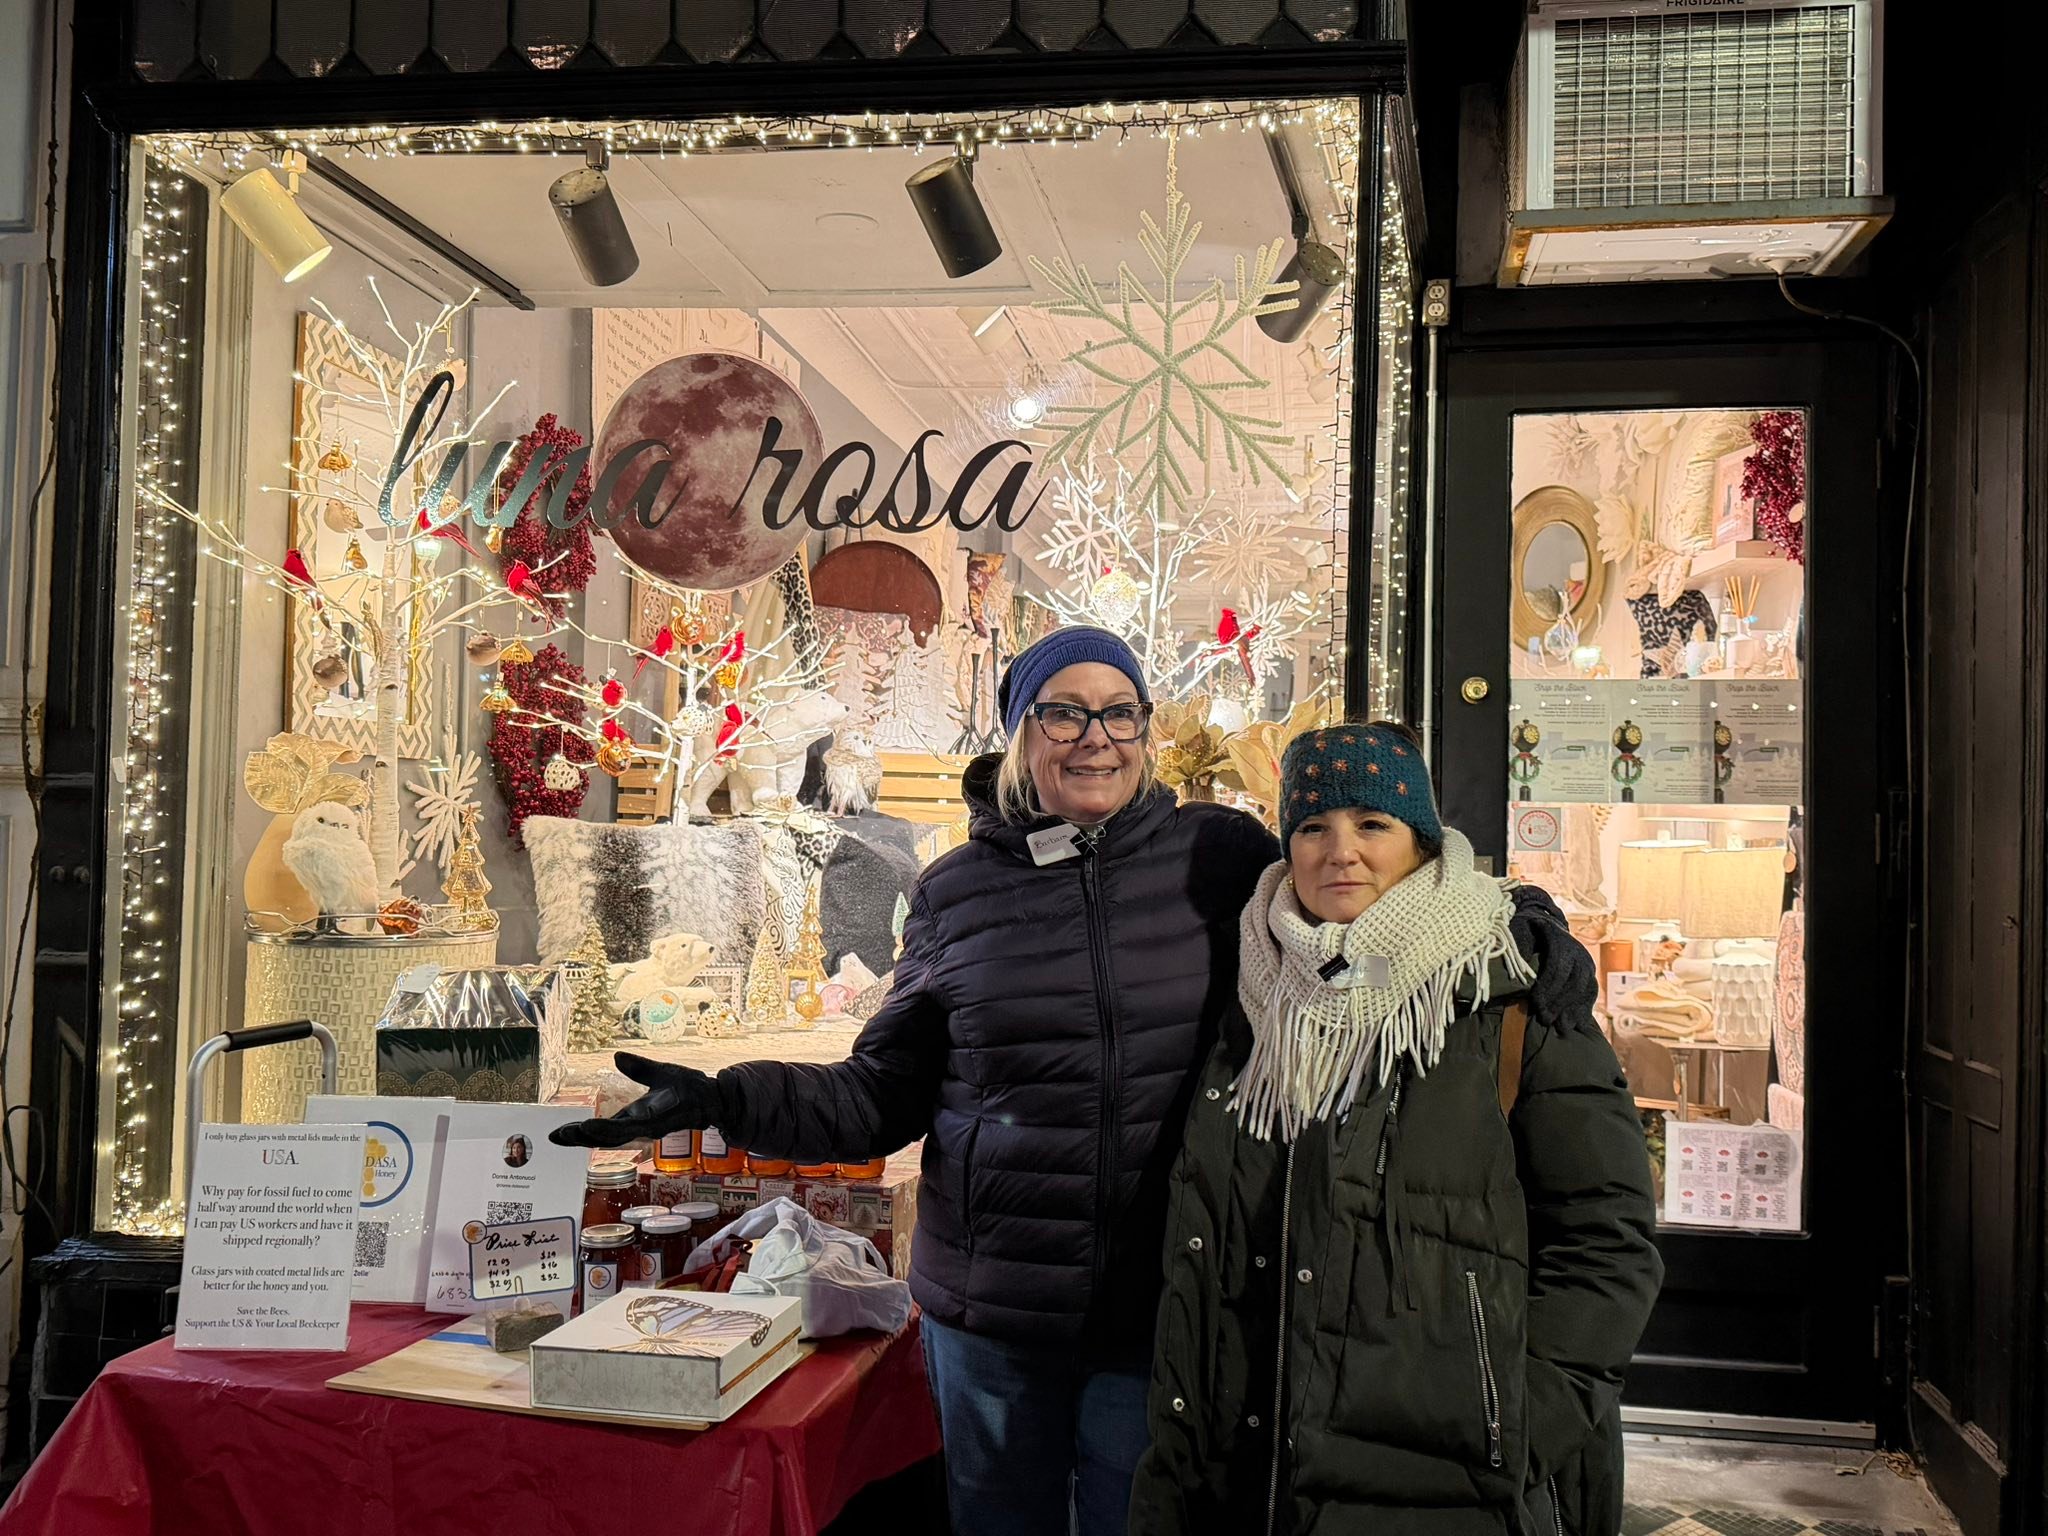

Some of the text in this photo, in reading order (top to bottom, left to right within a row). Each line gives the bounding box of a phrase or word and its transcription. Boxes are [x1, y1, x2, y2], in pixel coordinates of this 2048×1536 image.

[378, 371, 1049, 533] luna rosa
[205, 1132, 360, 1143] I only buy glass jars with metal lids made in the
[365, 1156, 397, 1168] DASA
[375, 1170, 397, 1179] Honey
[202, 1185, 225, 1200] Why
[226, 1188, 245, 1200] pay
[247, 1185, 261, 1197] for
[263, 1186, 289, 1197] fossil
[291, 1186, 311, 1197] fuel
[312, 1189, 323, 1197] to
[197, 1201, 352, 1216] half way around the world when
[193, 1219, 352, 1232] I can pay US workers and have it
[223, 1234, 320, 1249] shipped regionally?
[486, 1230, 560, 1251] Price List
[191, 1266, 345, 1279] Glass jars with coated metal lids are
[203, 1279, 328, 1294] better for the honey and you.
[437, 1285, 472, 1299] 683
[237, 1306, 290, 1316] Save the Bees.
[185, 1318, 340, 1331] Support the US & Your Local Beekeeper
